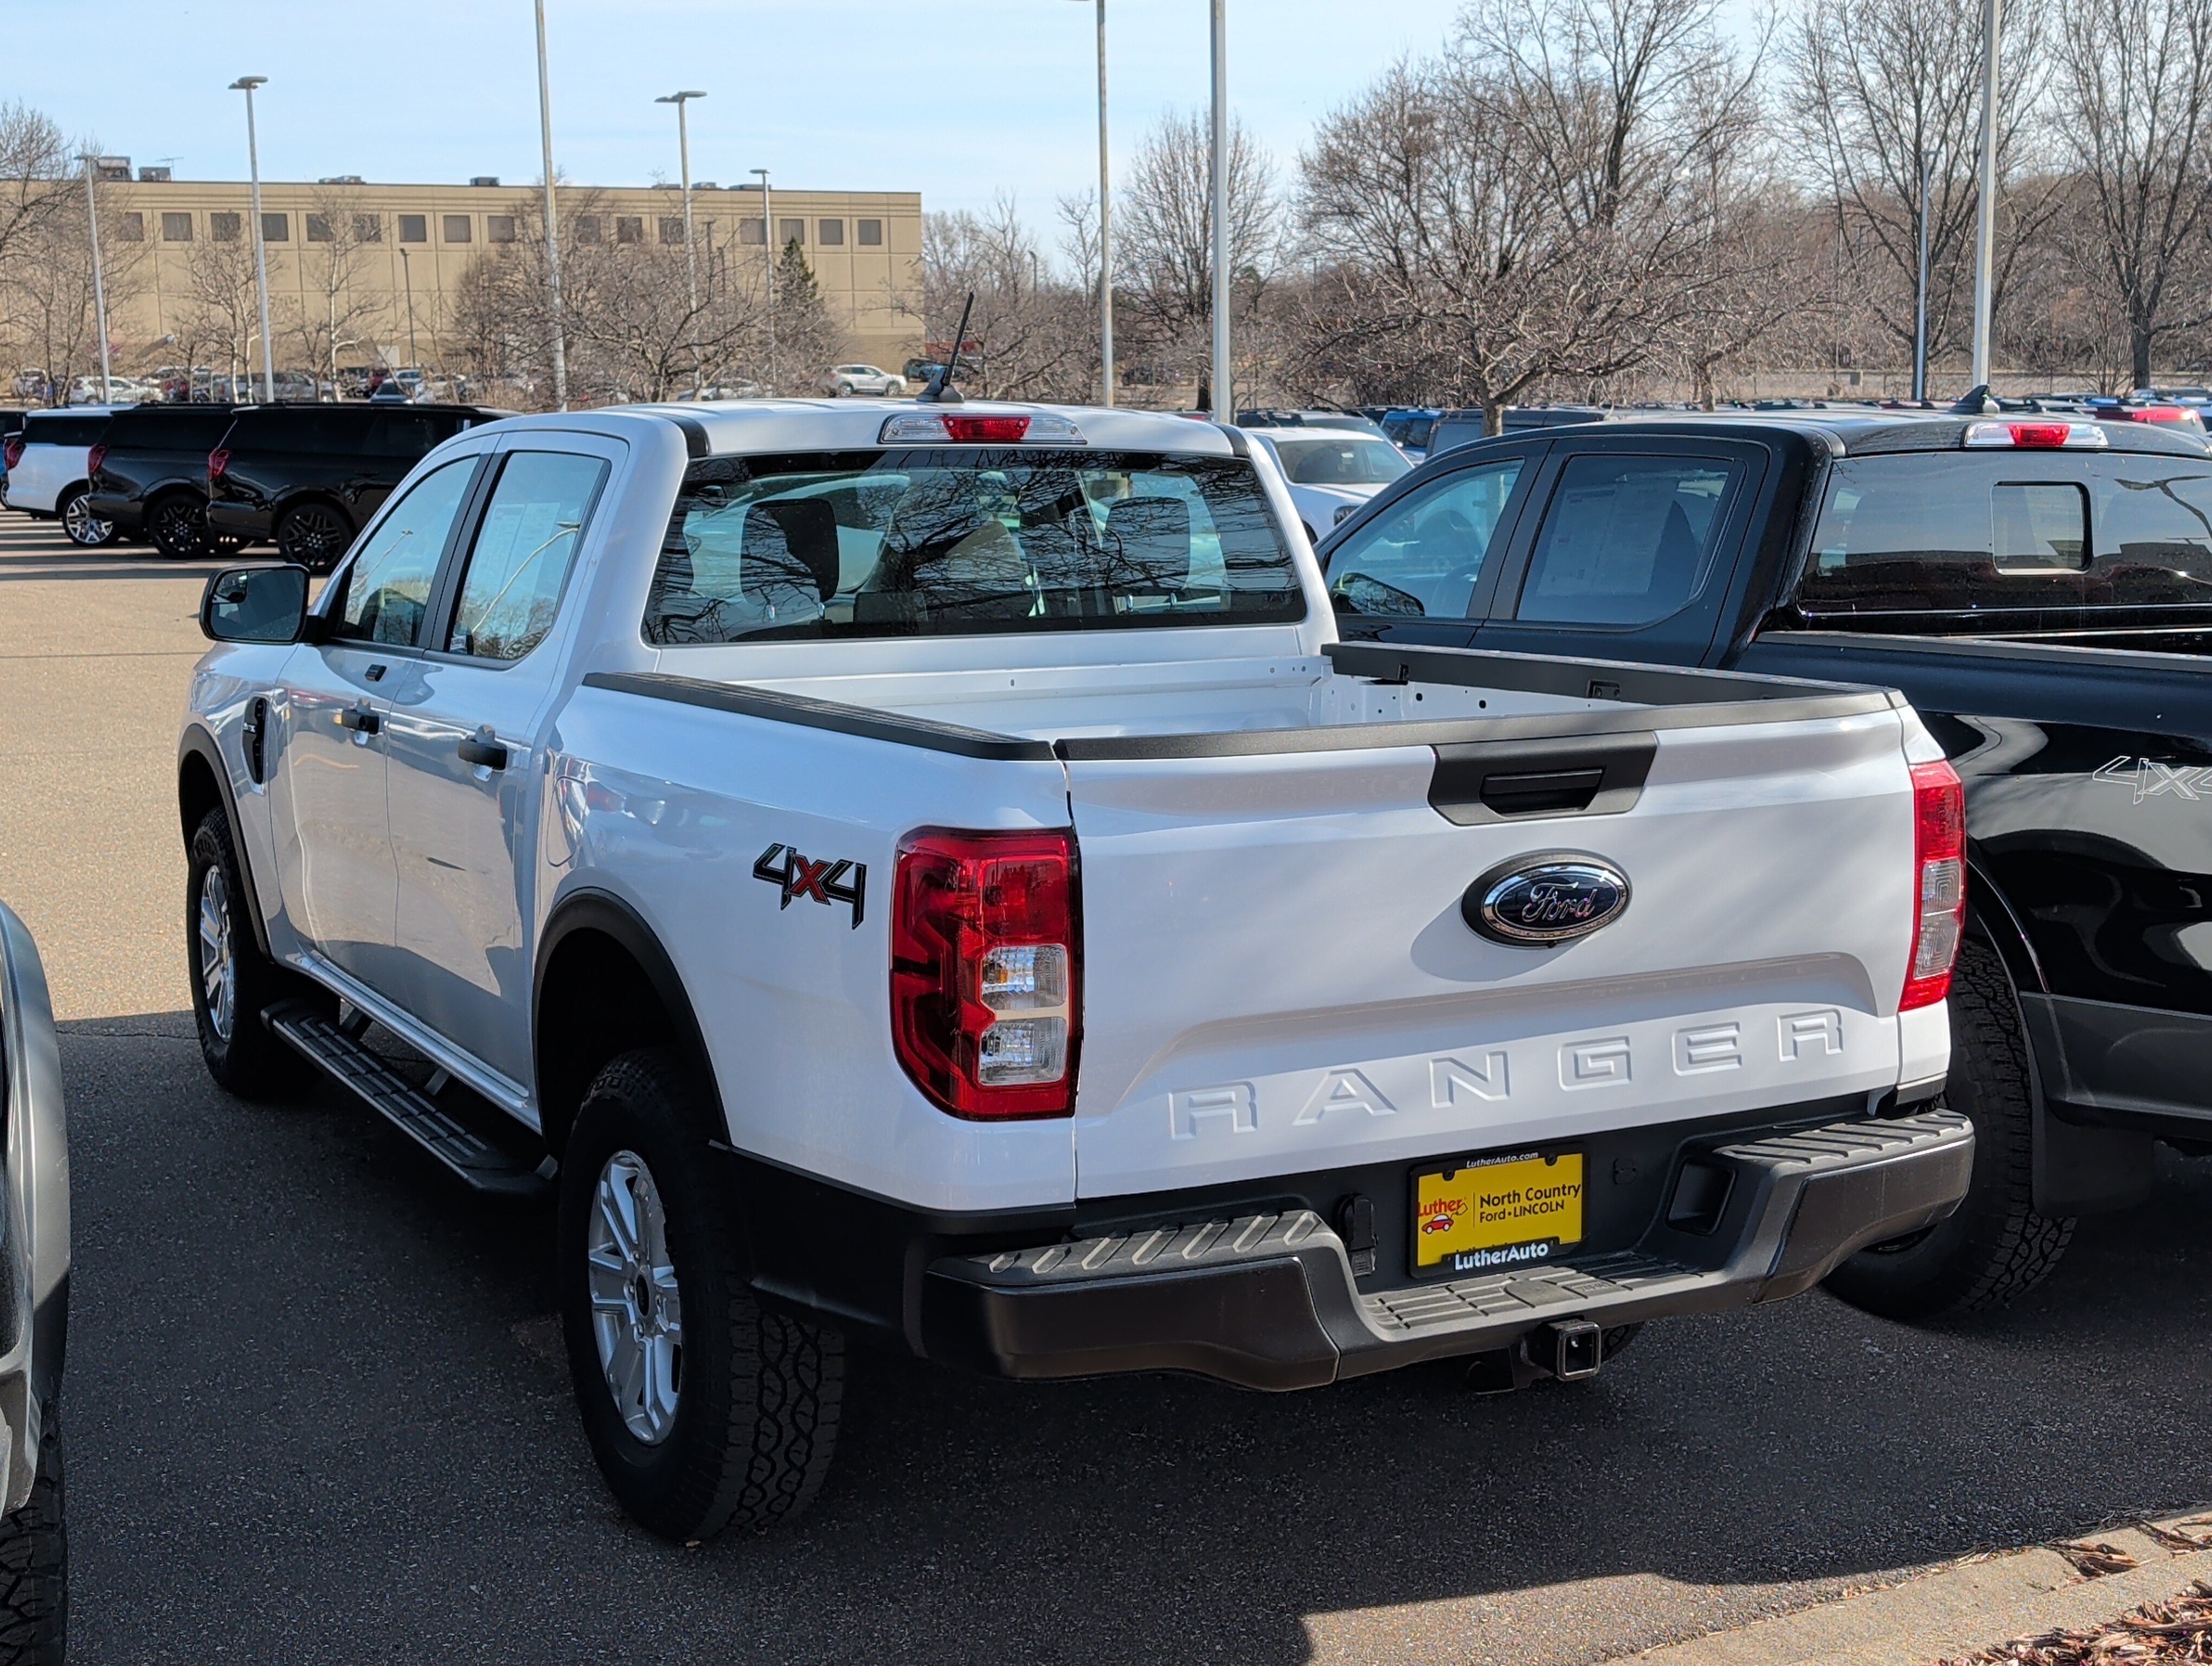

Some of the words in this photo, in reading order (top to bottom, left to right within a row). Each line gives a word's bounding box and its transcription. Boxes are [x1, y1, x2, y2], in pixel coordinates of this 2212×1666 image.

[1521, 881, 1598, 922] Ford
[1168, 1008, 1844, 1140] RANGER
[1466, 1152, 1539, 1168] LutherAuto.com
[1417, 1197, 1463, 1218] Luther
[1480, 1189, 1521, 1209] North
[1525, 1183, 1581, 1201] Country
[1455, 1242, 1549, 1271] LutherAuto
